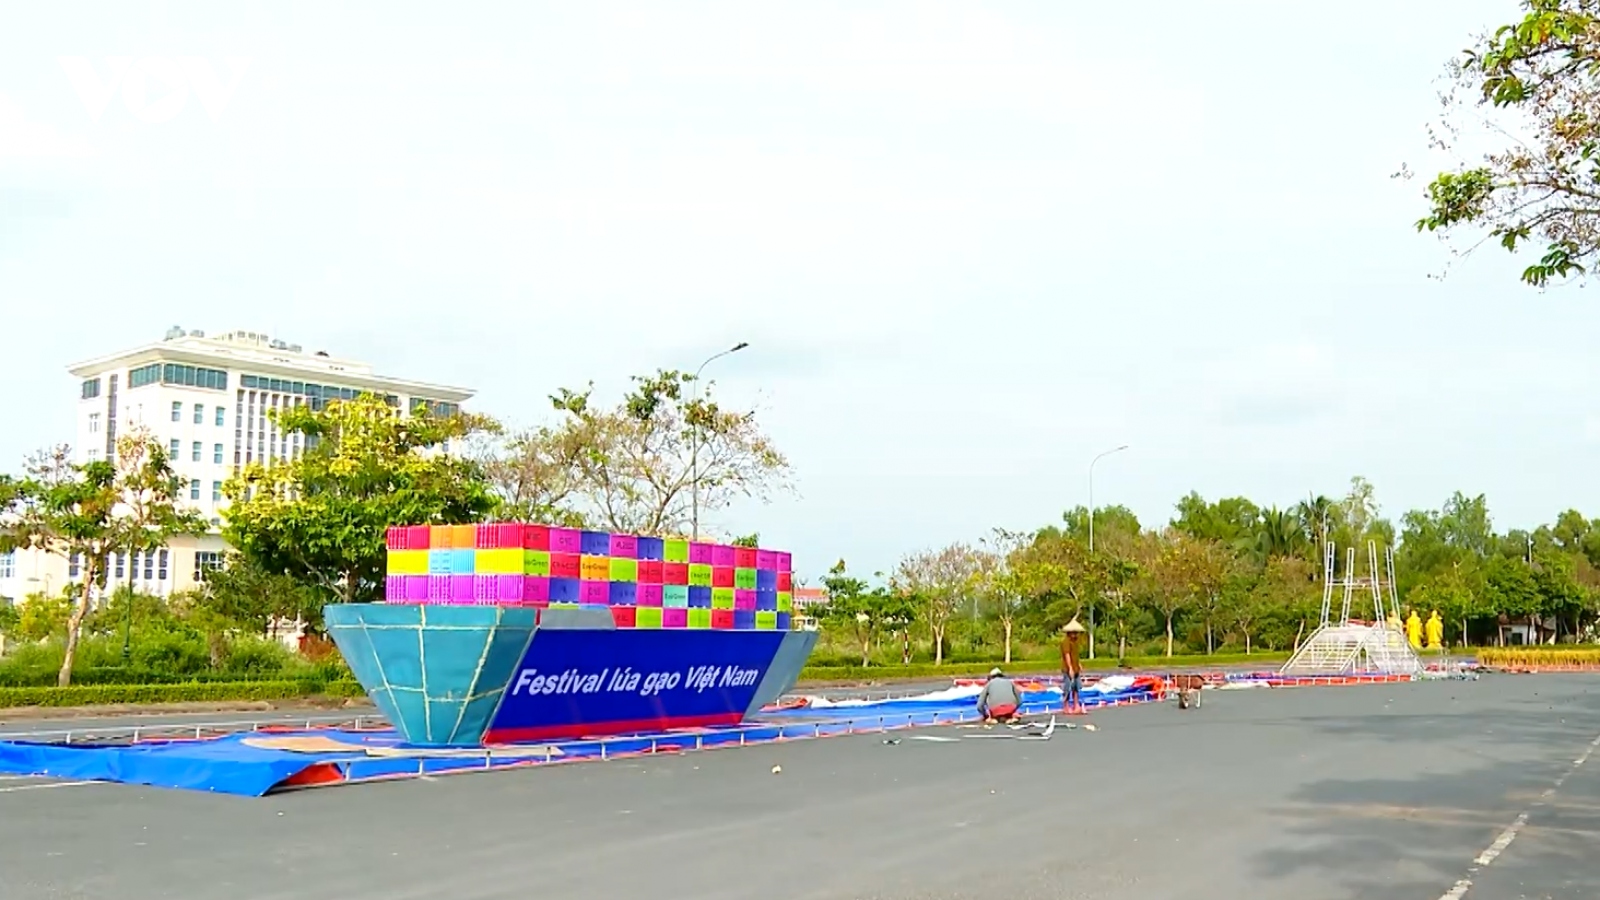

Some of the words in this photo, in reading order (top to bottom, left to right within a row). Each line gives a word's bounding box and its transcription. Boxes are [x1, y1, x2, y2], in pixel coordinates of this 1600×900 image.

[511, 667, 609, 696] Festival
[606, 666, 642, 692] lúa
[639, 671, 681, 696] gạo
[684, 665, 722, 694] Việt
[718, 664, 759, 688] Nam
